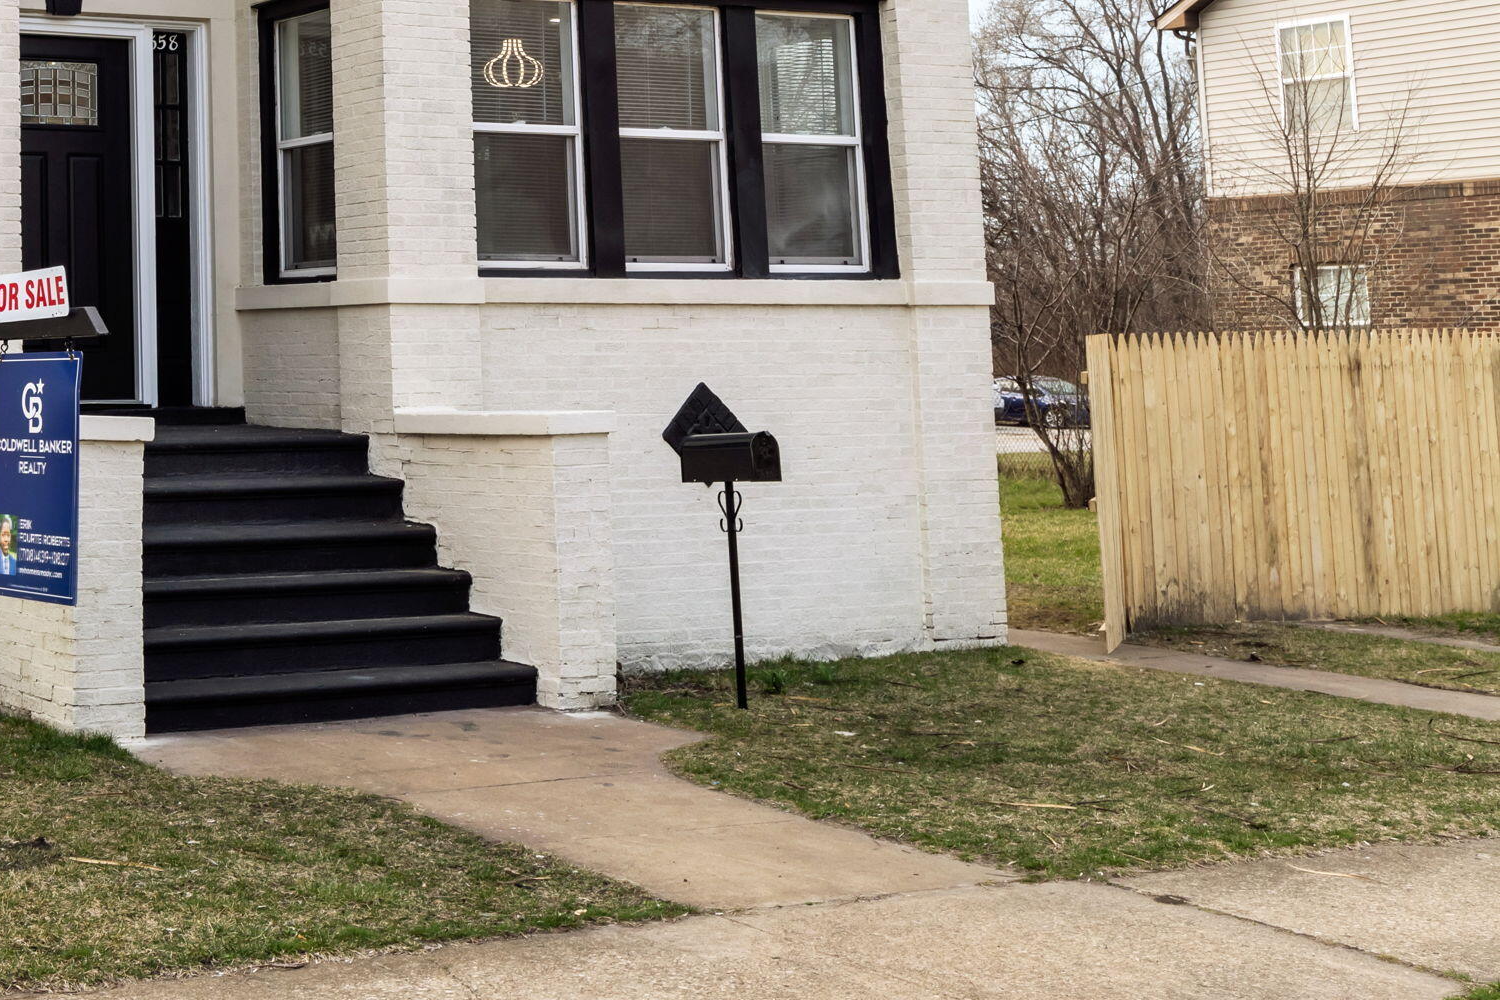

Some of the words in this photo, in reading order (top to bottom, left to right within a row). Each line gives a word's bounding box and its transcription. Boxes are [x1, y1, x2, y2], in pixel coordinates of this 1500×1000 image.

[25, 275, 65, 309] SALE
[38, 438, 73, 454] BANKER
[18, 461, 47, 475] REALTY
[19, 518, 33, 530] ERIK
[43, 534, 71, 547] ROBERTS
